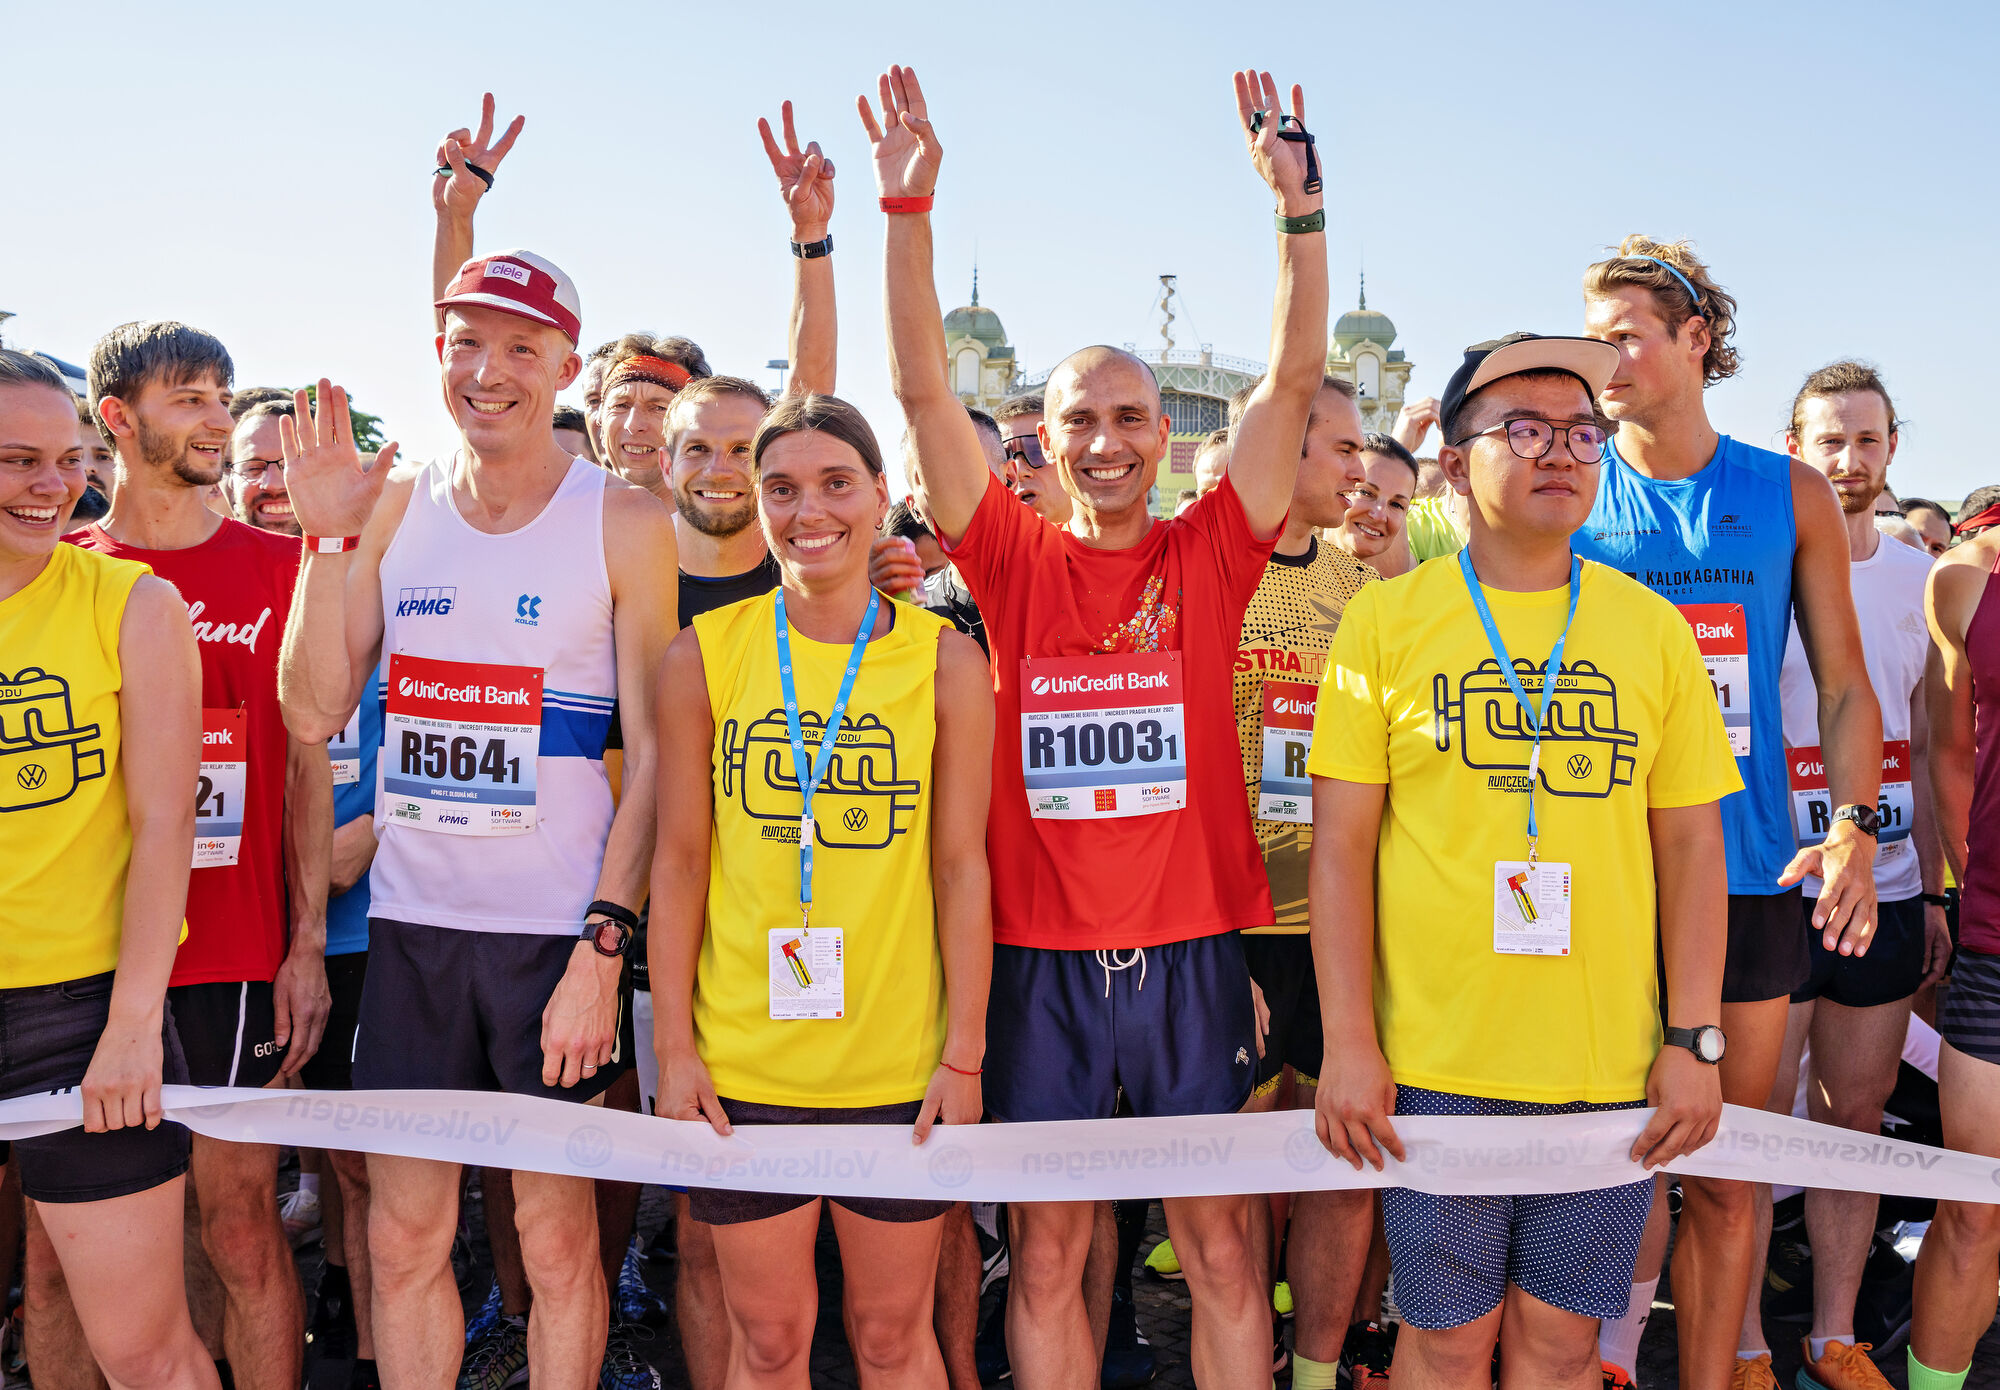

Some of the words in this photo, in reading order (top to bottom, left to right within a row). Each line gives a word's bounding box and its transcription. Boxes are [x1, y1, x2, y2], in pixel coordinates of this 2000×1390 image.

[492, 264, 523, 280] ciele
[1646, 568, 1755, 586] KALOKAGATHIA
[1654, 587, 1693, 595] IANCE
[396, 598, 452, 617] KPMG
[184, 601, 272, 654] land
[1696, 622, 1735, 639] Bank
[1052, 673, 1125, 694] UniCredit
[1128, 671, 1169, 689] Bank
[1499, 678, 1534, 687] MOR
[414, 679, 481, 704] UniCredit
[485, 685, 530, 706] Bank
[203, 728, 233, 744] ank
[1882, 755, 1900, 769] nk
[438, 815, 469, 825] KPMG
[761, 825, 802, 839] RUNCZEC
